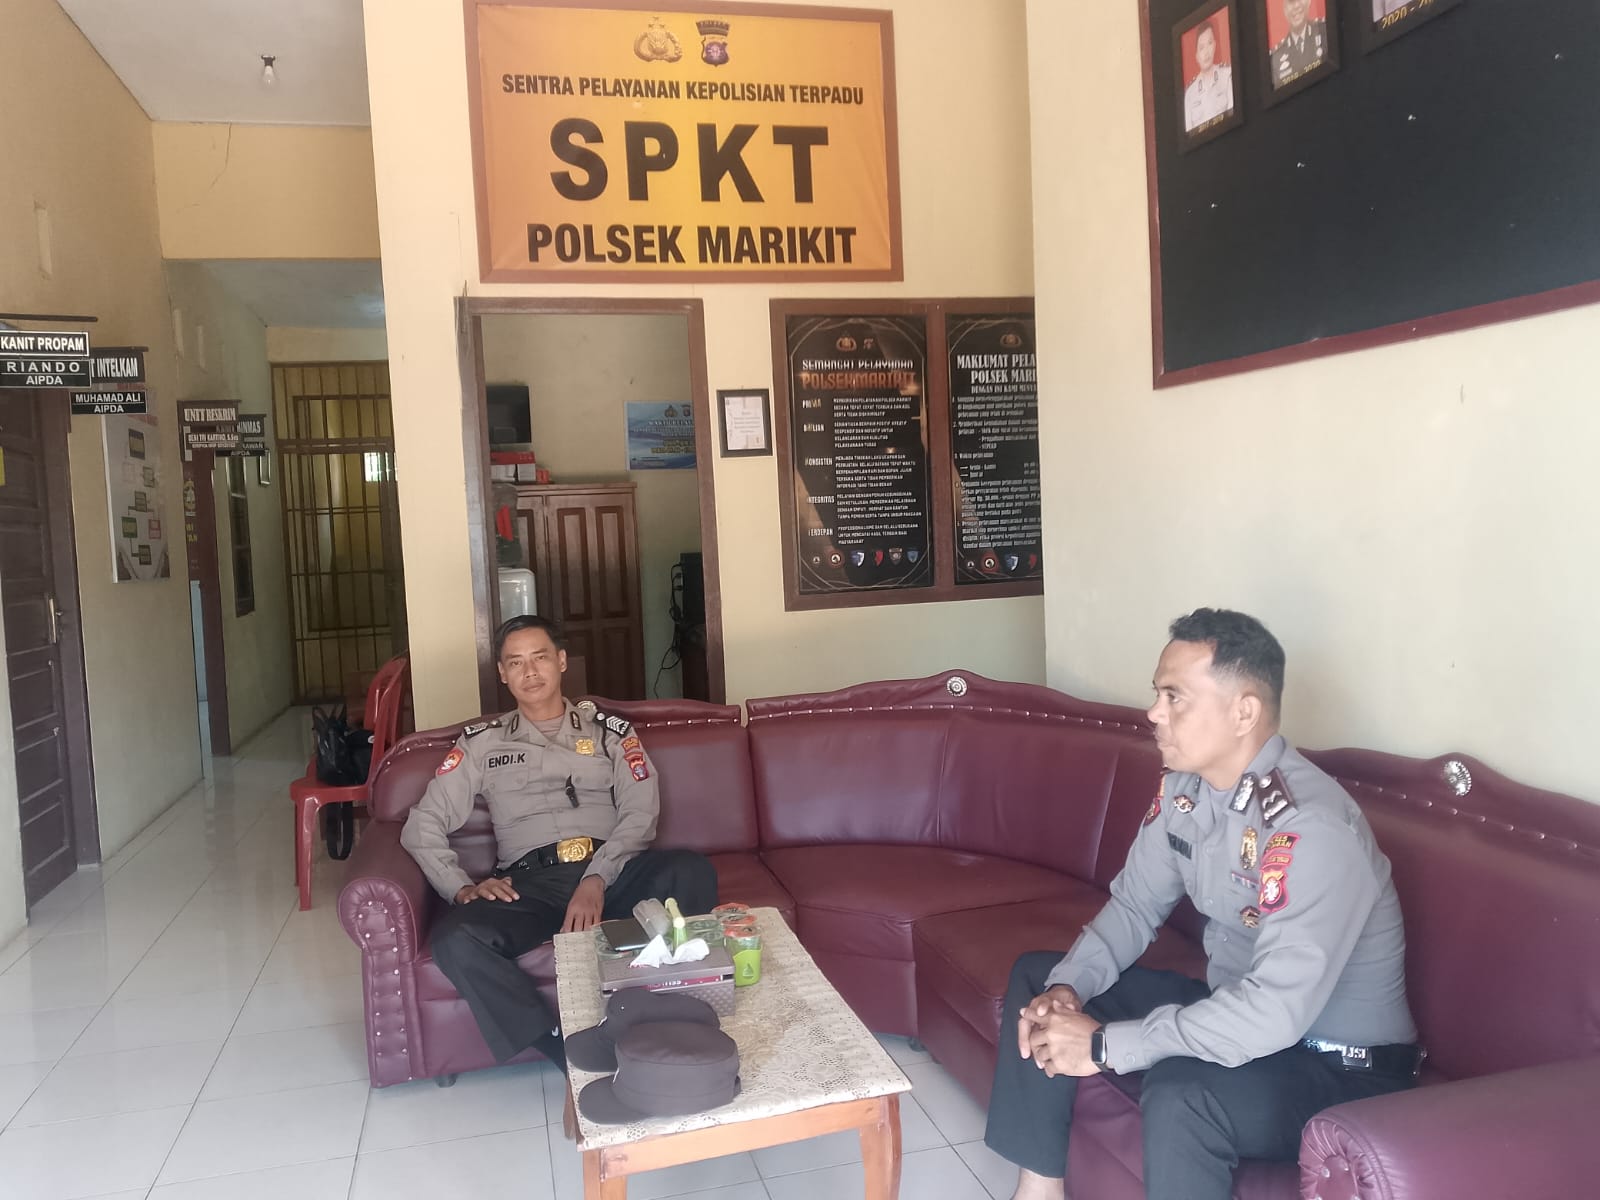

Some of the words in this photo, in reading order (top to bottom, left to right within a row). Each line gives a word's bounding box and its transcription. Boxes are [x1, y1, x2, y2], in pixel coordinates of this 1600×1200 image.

[502, 74, 574, 96] SENTRA
[579, 76, 680, 100] PELAYANAN
[686, 80, 785, 103] KEPOLISIAN
[790, 85, 864, 105] TERPADU
[550, 117, 829, 204] SPKT
[527, 223, 686, 264] POLSEK
[698, 226, 857, 264] MARIKIT
[0, 336, 35, 350] KANIT
[38, 336, 84, 351] PROPAM
[6, 361, 80, 372] RIANDO
[96, 358, 138, 378] INTELKAM
[957, 354, 1008, 368] MAKLUMAT
[26, 376, 63, 385] AIPDA
[971, 369, 1008, 384] POLSEK
[76, 393, 124, 402] MUHAMAD
[126, 392, 140, 402] ALI
[94, 404, 124, 413] AIPDA
[488, 752, 526, 768] ENDI.K
